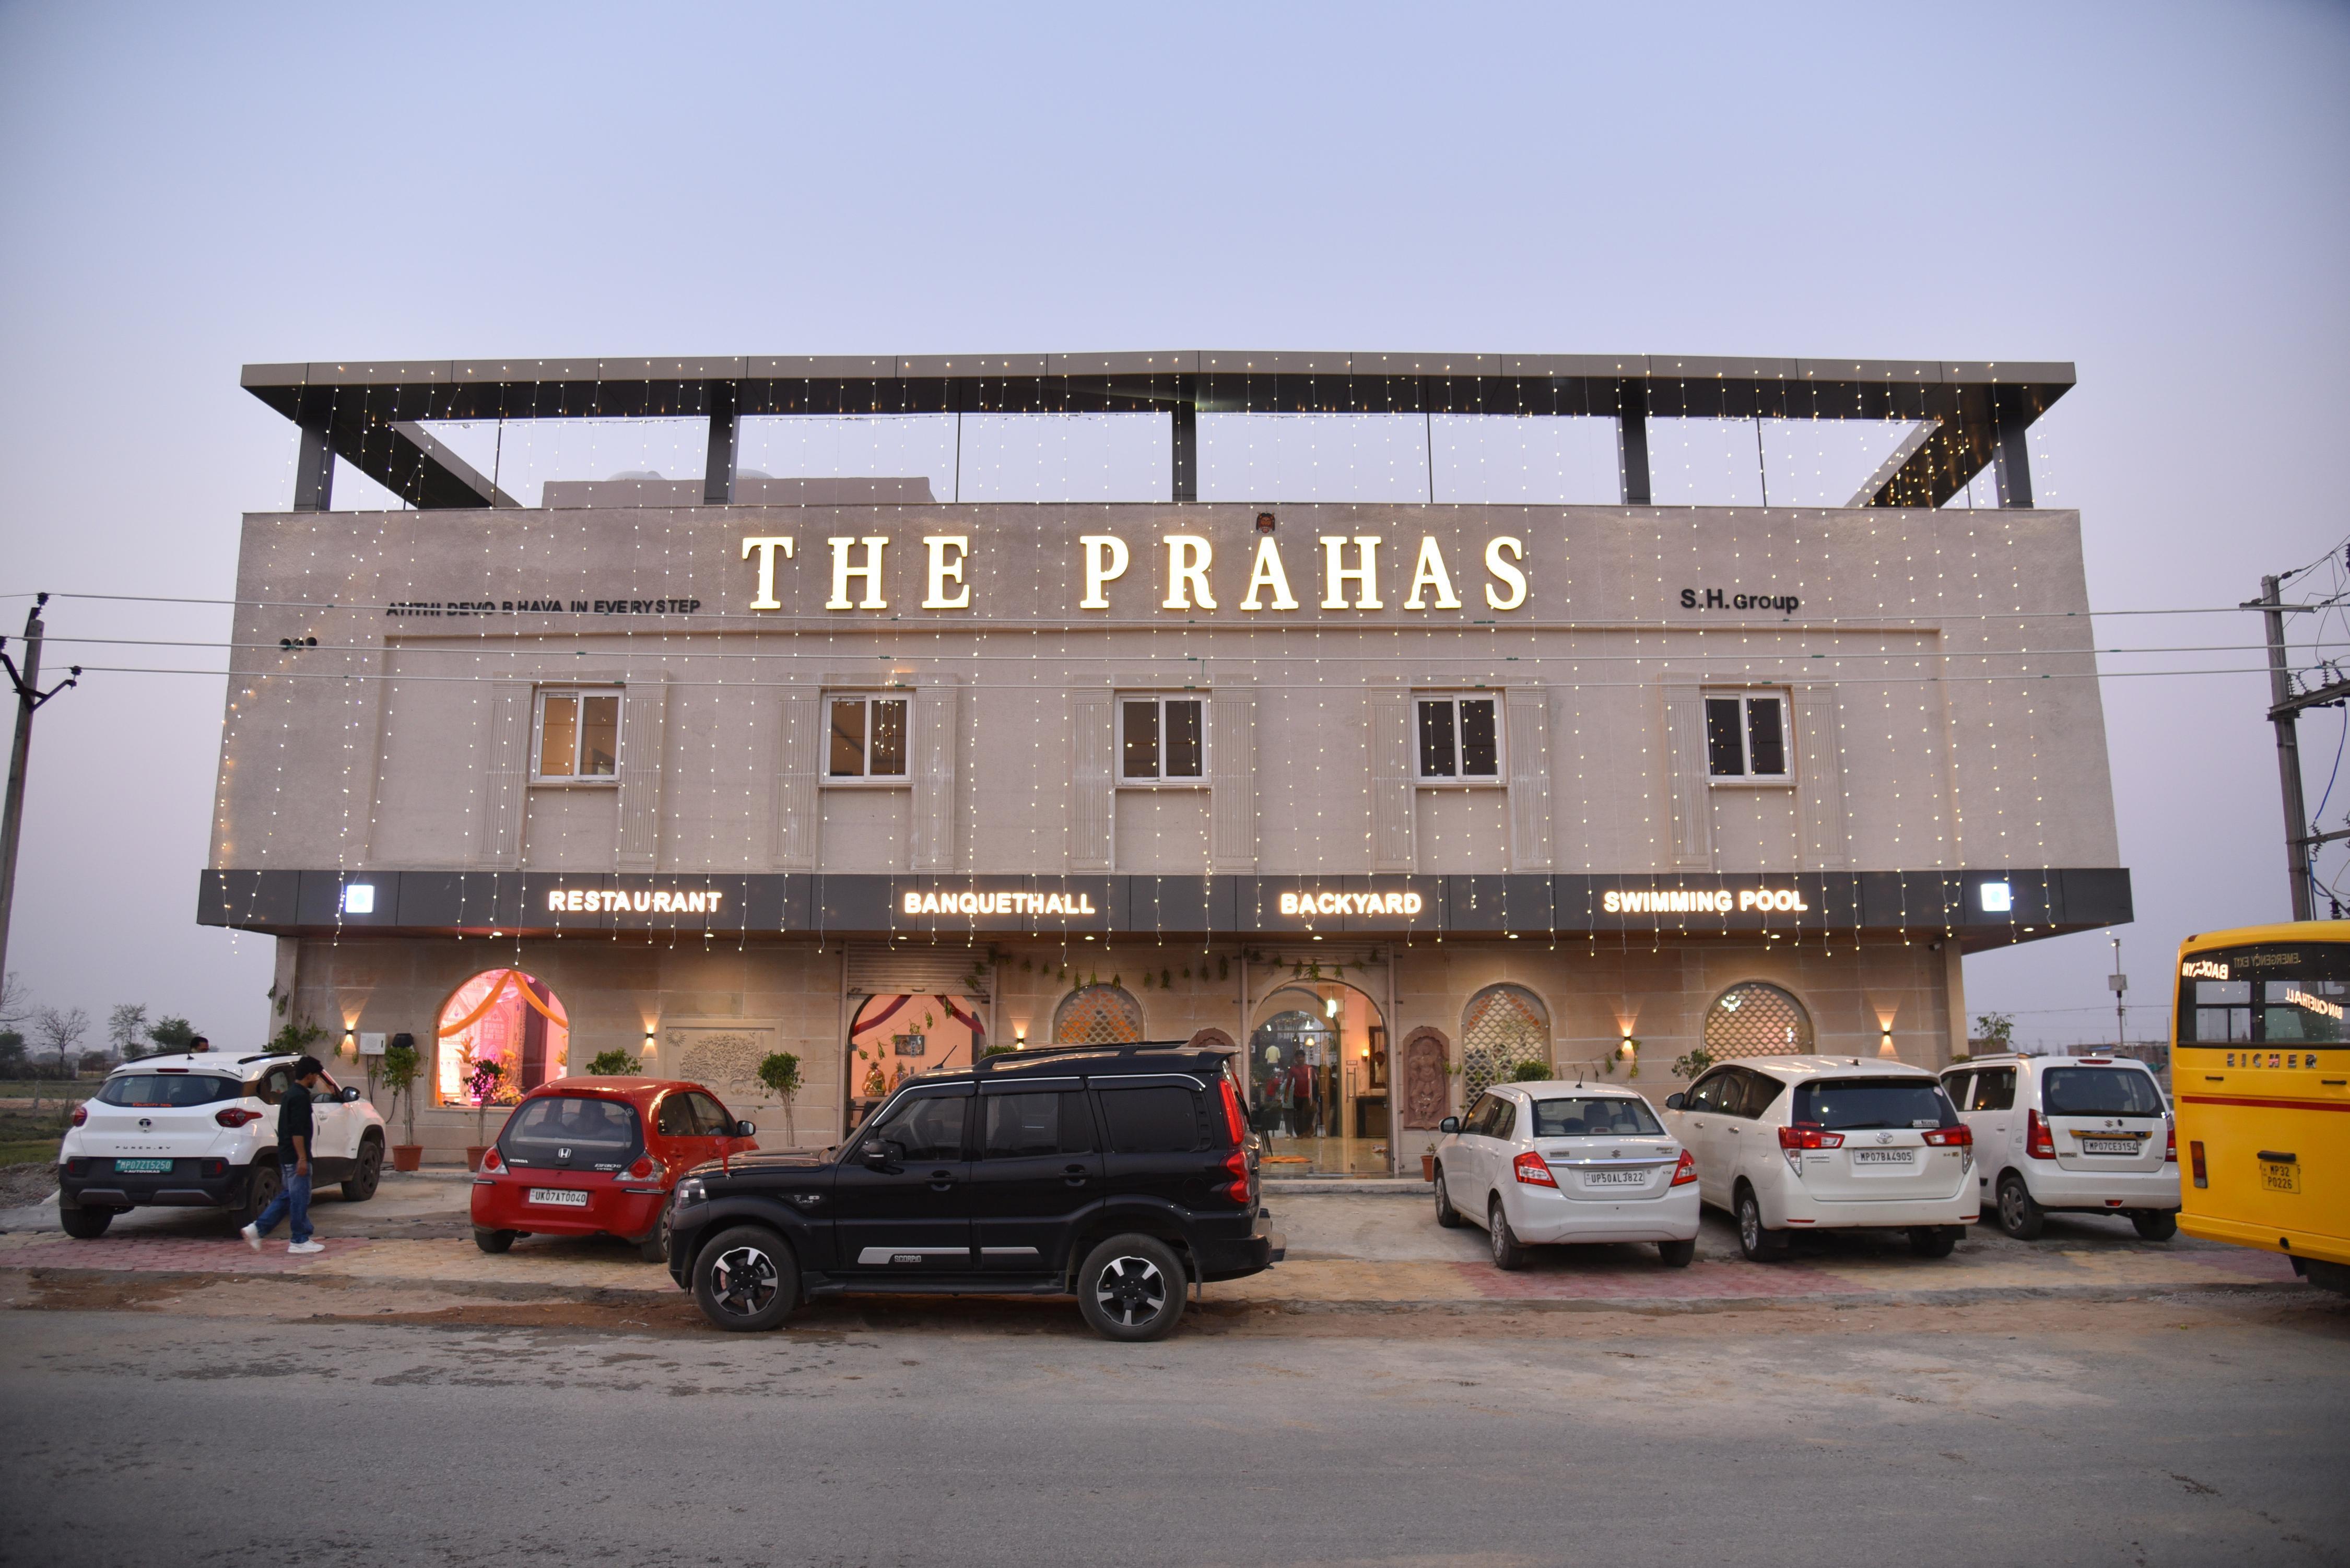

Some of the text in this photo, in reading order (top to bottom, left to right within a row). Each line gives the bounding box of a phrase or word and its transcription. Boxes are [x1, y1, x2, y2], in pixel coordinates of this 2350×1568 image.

[742, 535, 1528, 610] THE PRAHAS
[386, 602, 441, 616] ATITHI
[446, 601, 496, 616] DEVO
[571, 600, 588, 612] IN
[1733, 594, 1799, 614] Group
[549, 891, 722, 912] RESTAURANT
[904, 892, 1096, 915] BANQUETHALL
[1281, 892, 1421, 914] BACKYARD
[1604, 890, 1808, 913] SWIMMING POOL
[2227, 1053, 2318, 1069] EICHER
[894, 1255, 922, 1264] SCORPIO
